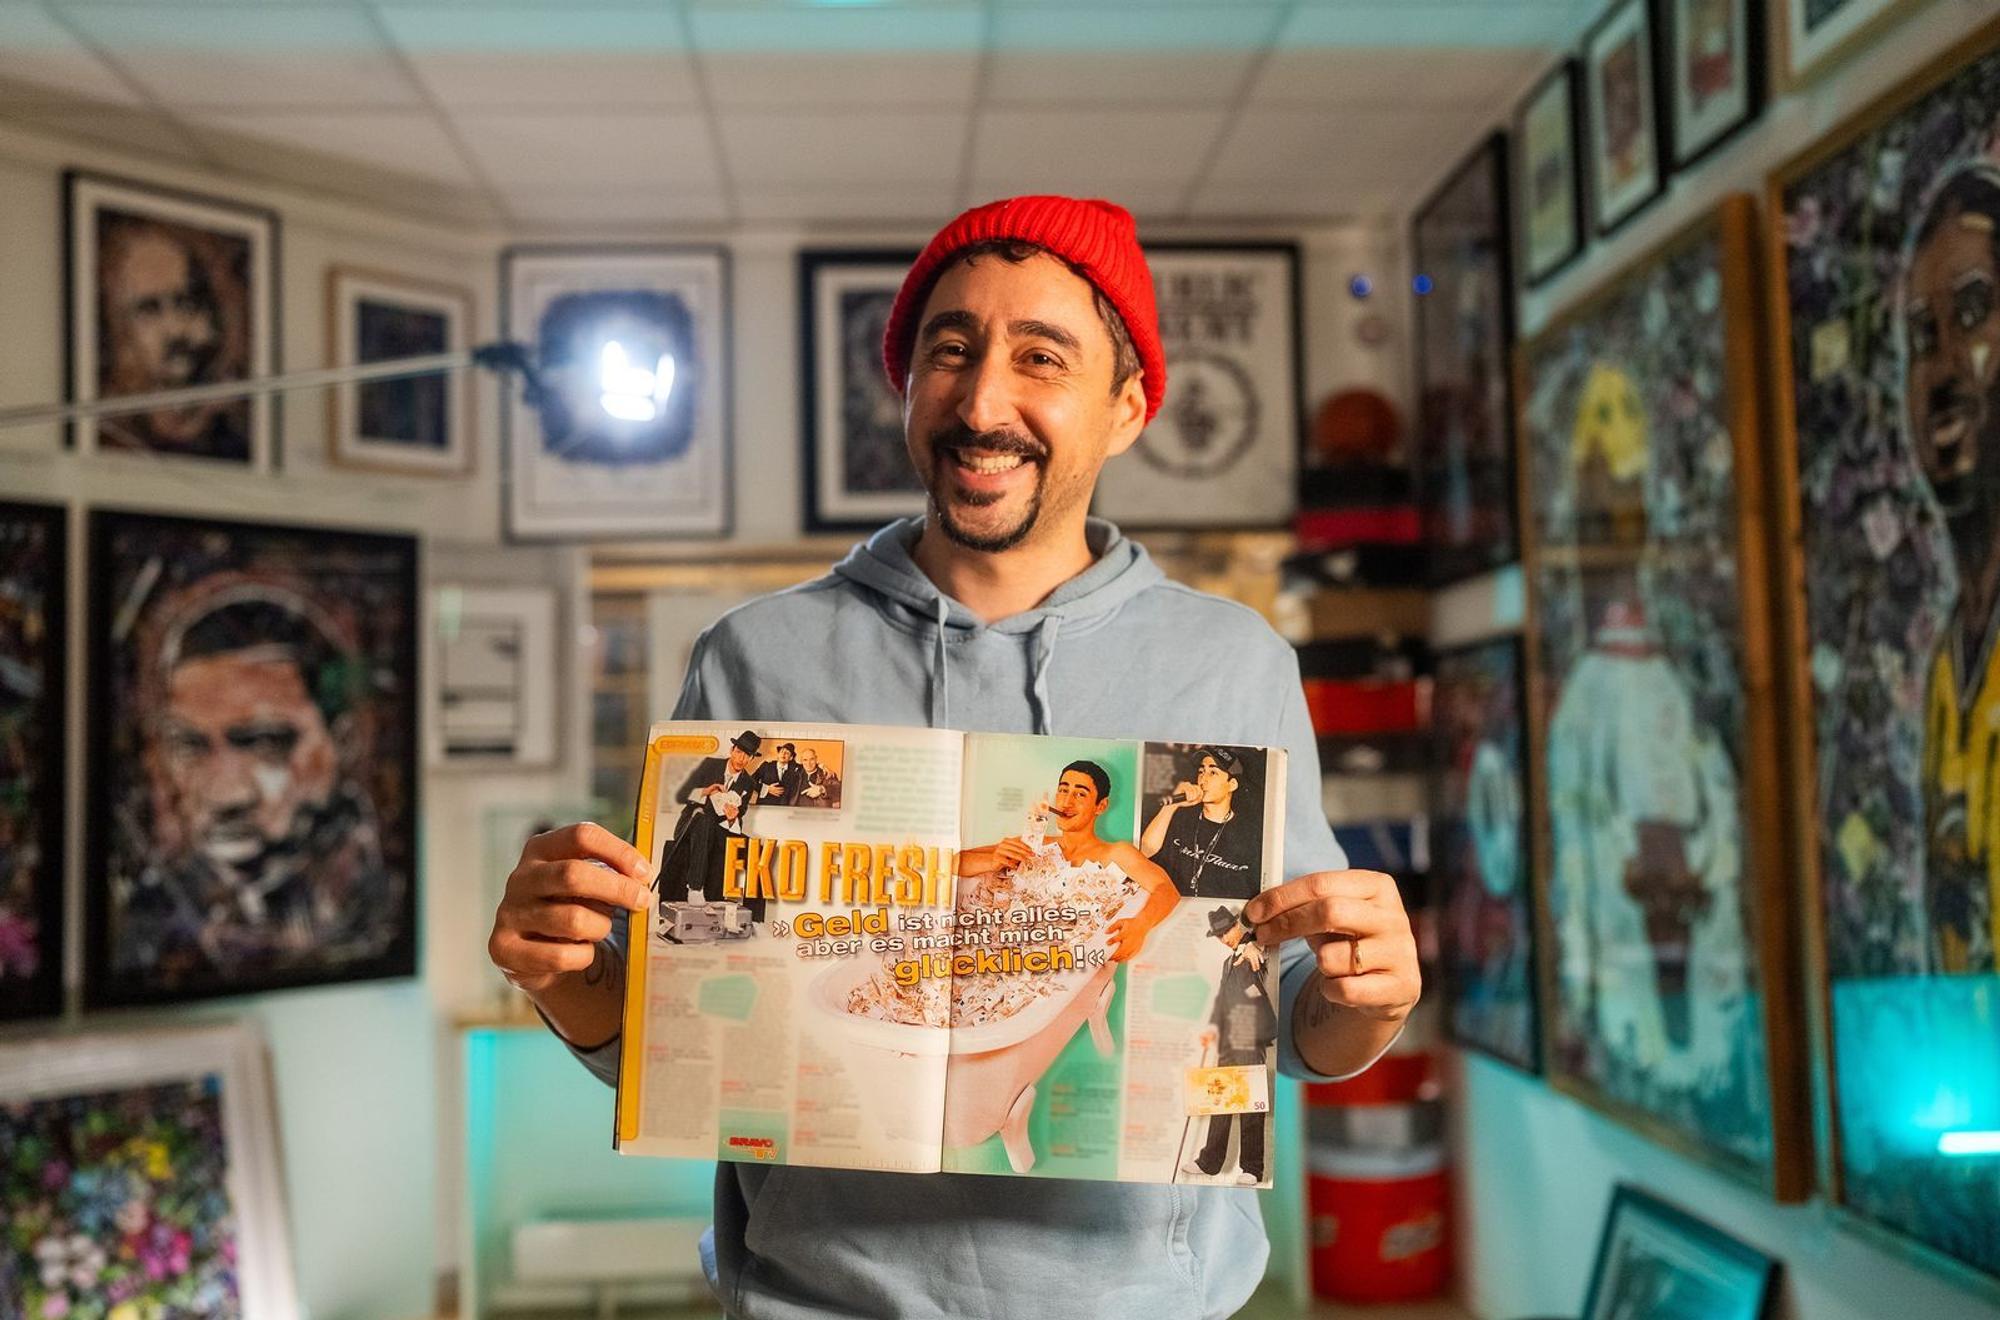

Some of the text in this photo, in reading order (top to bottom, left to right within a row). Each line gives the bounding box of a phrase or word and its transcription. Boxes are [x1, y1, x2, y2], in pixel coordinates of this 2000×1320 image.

[723, 836, 809, 899] EKO
[898, 913, 933, 931] ist
[941, 908, 1003, 928] nicht
[796, 926, 1064, 957] aber es macht mich
[1254, 1101, 1266, 1110] 50
